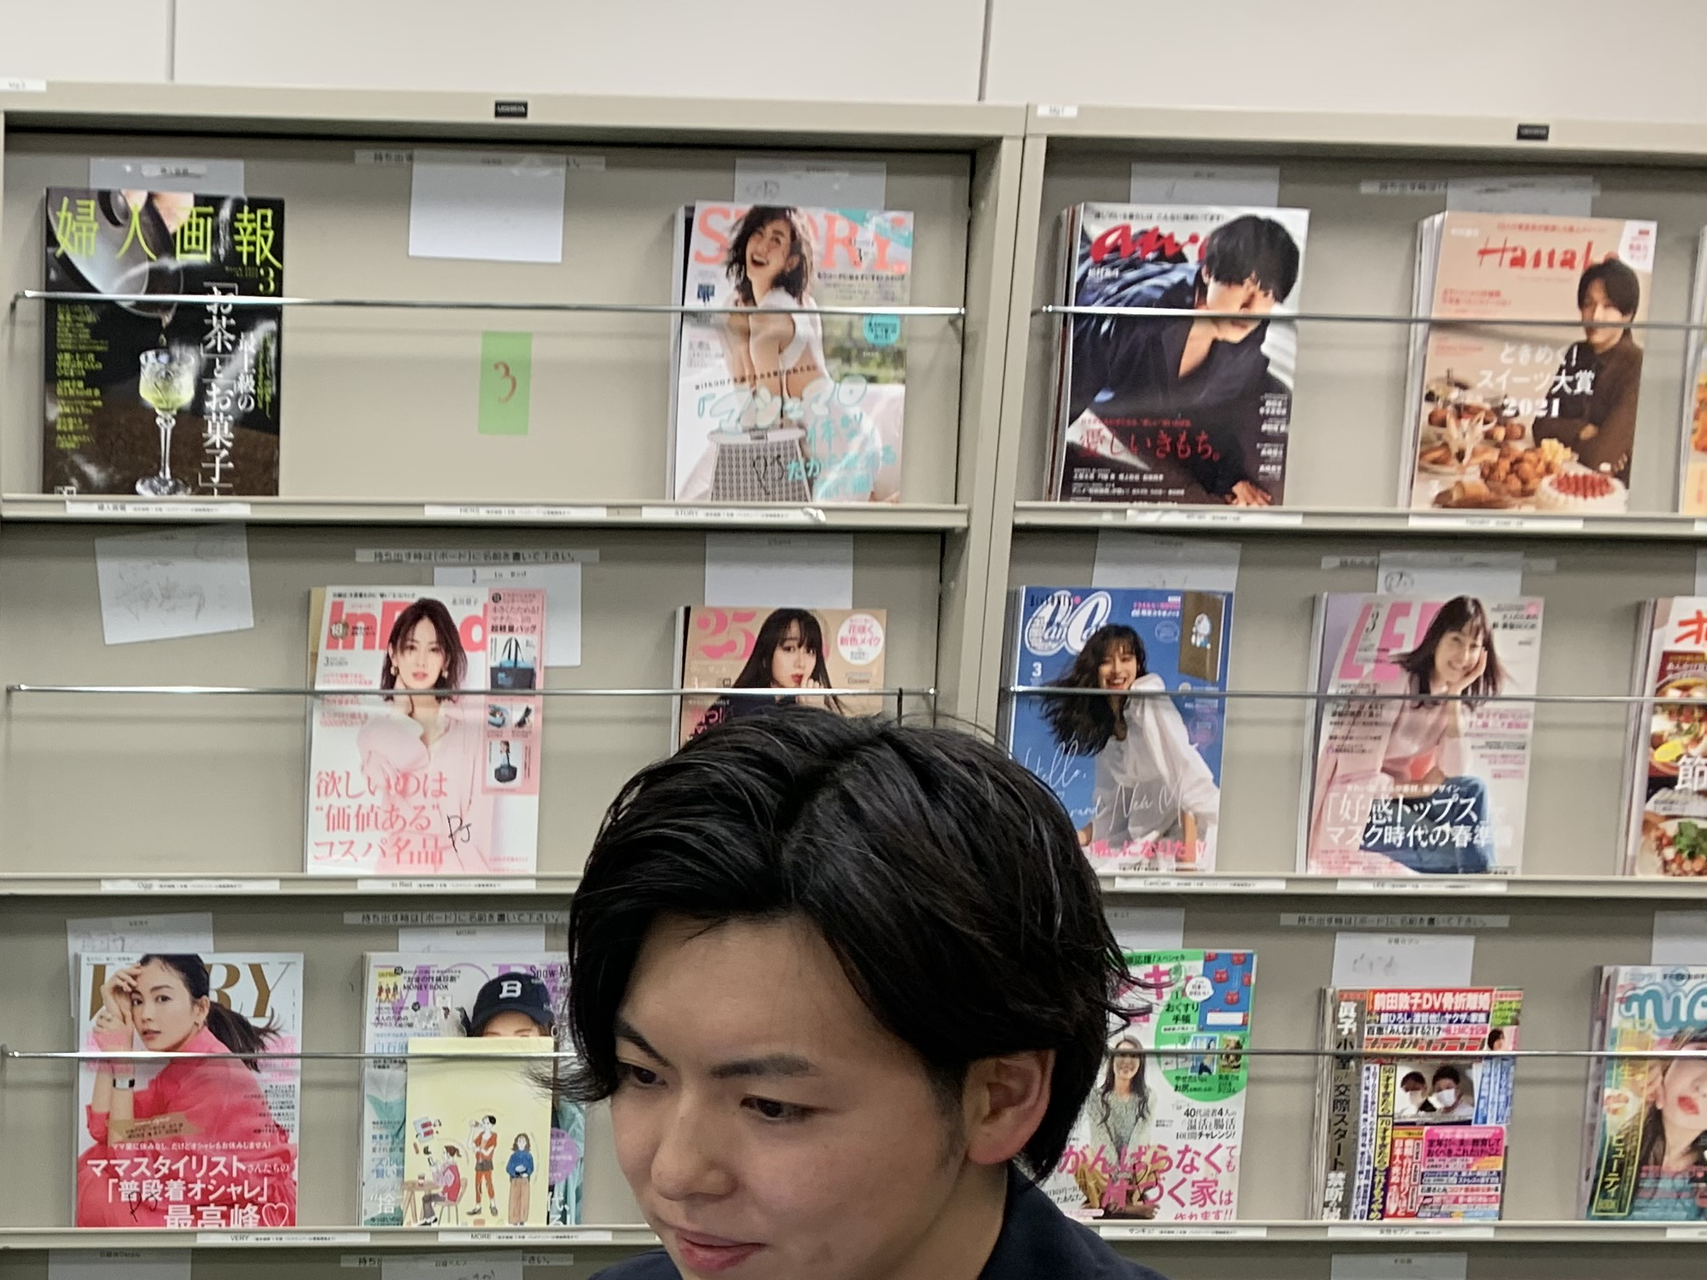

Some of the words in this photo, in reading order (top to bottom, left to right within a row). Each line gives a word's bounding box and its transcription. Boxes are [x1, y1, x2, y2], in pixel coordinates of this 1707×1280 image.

[55, 196, 283, 270] 婦人画報
[257, 266, 276, 294] 3
[1500, 343, 1578, 366] ときめく!
[494, 361, 517, 404] 3
[1477, 370, 1595, 395] スイーツ大賞
[1502, 399, 1559, 417] 2021
[490, 625, 537, 634] 超軽量バッグ
[1032, 661, 1042, 677] 3
[315, 771, 448, 799] 欲しいのは
[315, 803, 440, 833] “価値ある”
[312, 837, 444, 865] コスパ名品
[529, 965, 557, 978] Snow
[499, 980, 522, 999] B
[1165, 1002, 1199, 1013] おくすり
[1172, 1013, 1191, 1024] 手帳
[107, 1178, 270, 1204] 「普段着オシャレ」
[164, 1203, 261, 1229] 最高峰
